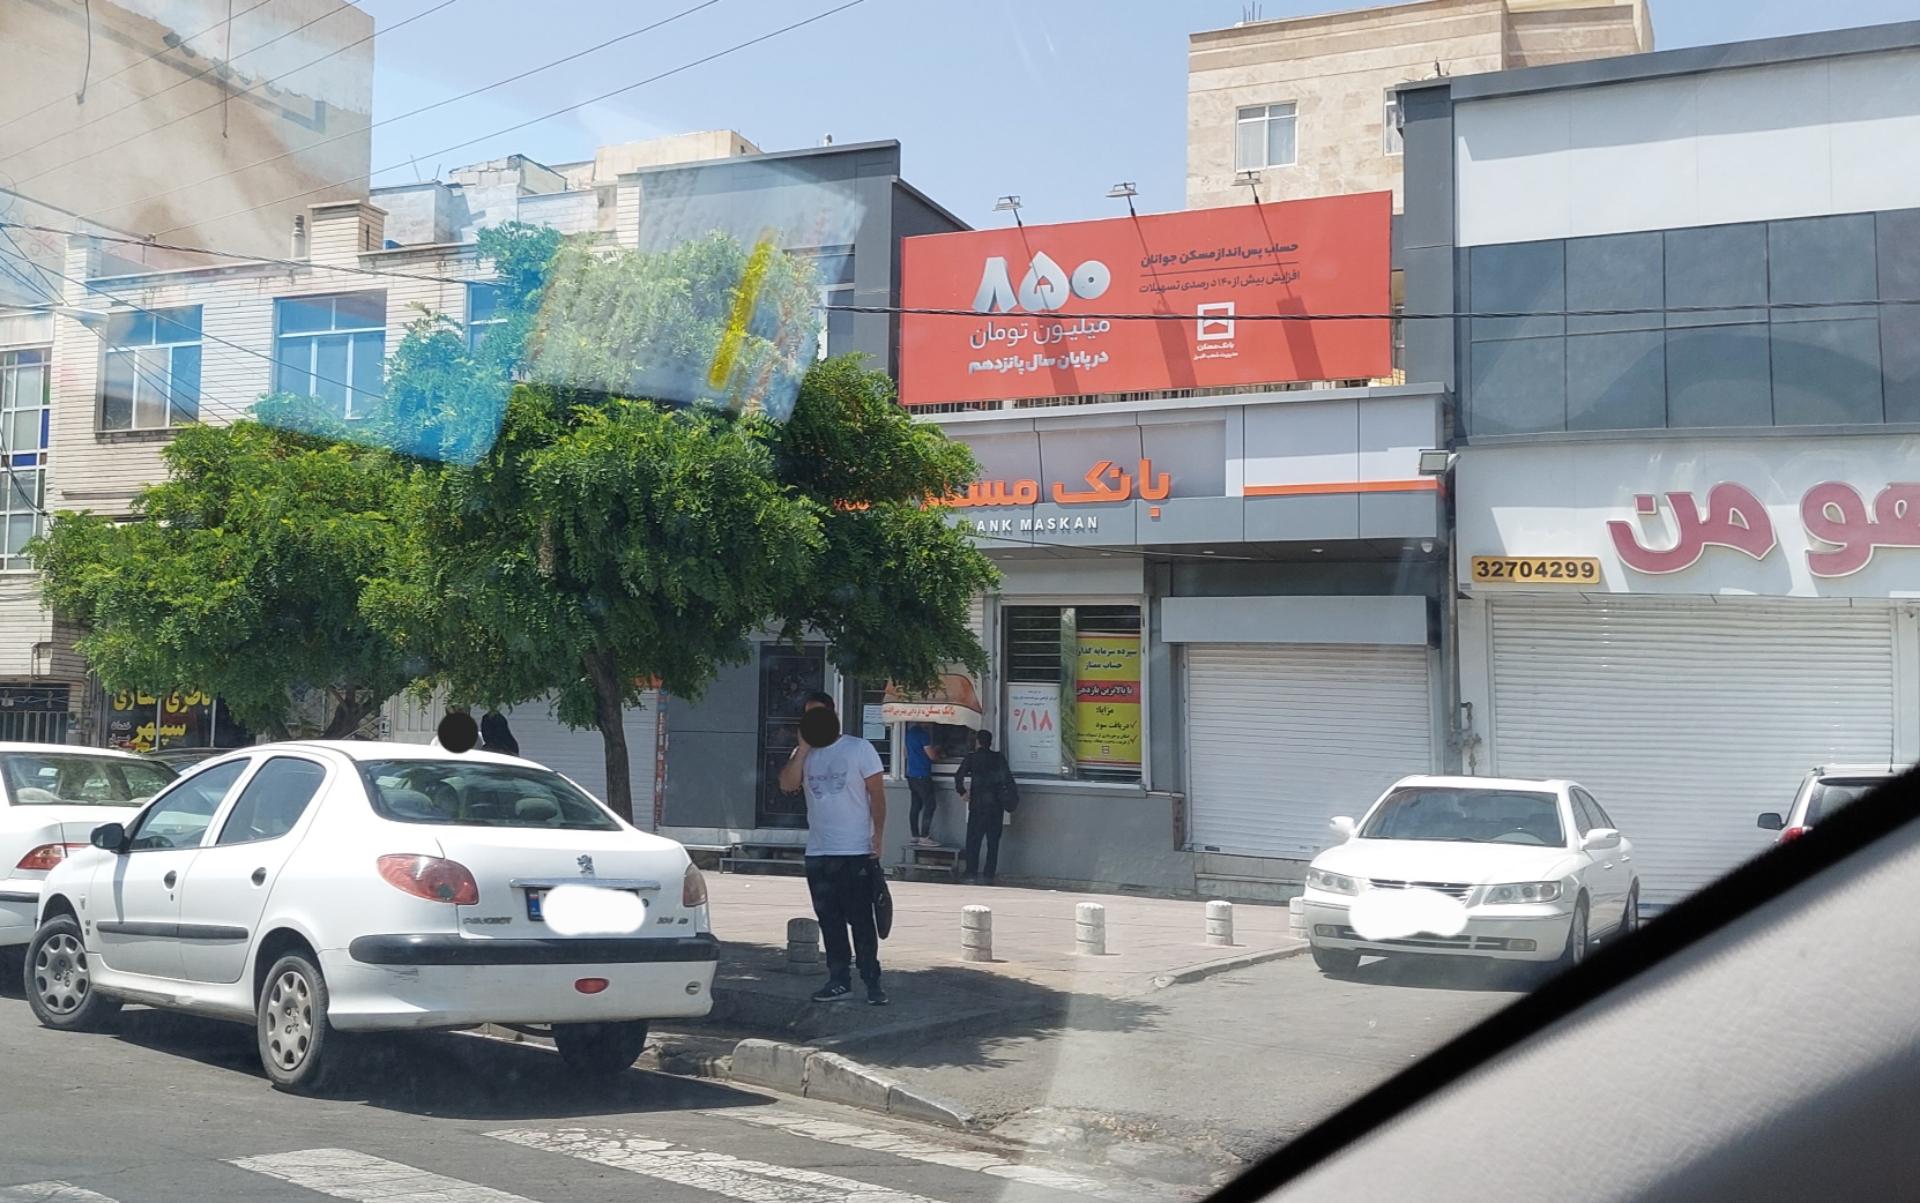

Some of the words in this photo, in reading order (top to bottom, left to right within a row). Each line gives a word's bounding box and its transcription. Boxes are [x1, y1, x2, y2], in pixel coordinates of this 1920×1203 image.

[1180, 249, 1217, 264] مسکن
[1265, 242, 1299, 257] حساب
[1141, 253, 1177, 268] جوانان
[972, 250, 1111, 313] ۸۵۰
[1240, 275, 1265, 287] بیش
[1265, 270, 1301, 286] افزایش
[1138, 281, 1180, 294] تسهیلات
[969, 320, 1029, 349] تومان
[1033, 315, 1111, 345] میلیون
[968, 355, 1025, 375] پانزدهم
[1025, 353, 1055, 371] سال
[1056, 350, 1092, 370] پایان
[1093, 350, 1110, 366] در
[920, 475, 1039, 511] مس
[1051, 457, 1172, 519] بانک
[968, 519, 1013, 533] ANK
[1020, 516, 1098, 531] MASKAN
[1476, 559, 1595, 579] 32704299
[1102, 661, 1123, 669] حساب
[129, 721, 187, 746] سپهر
